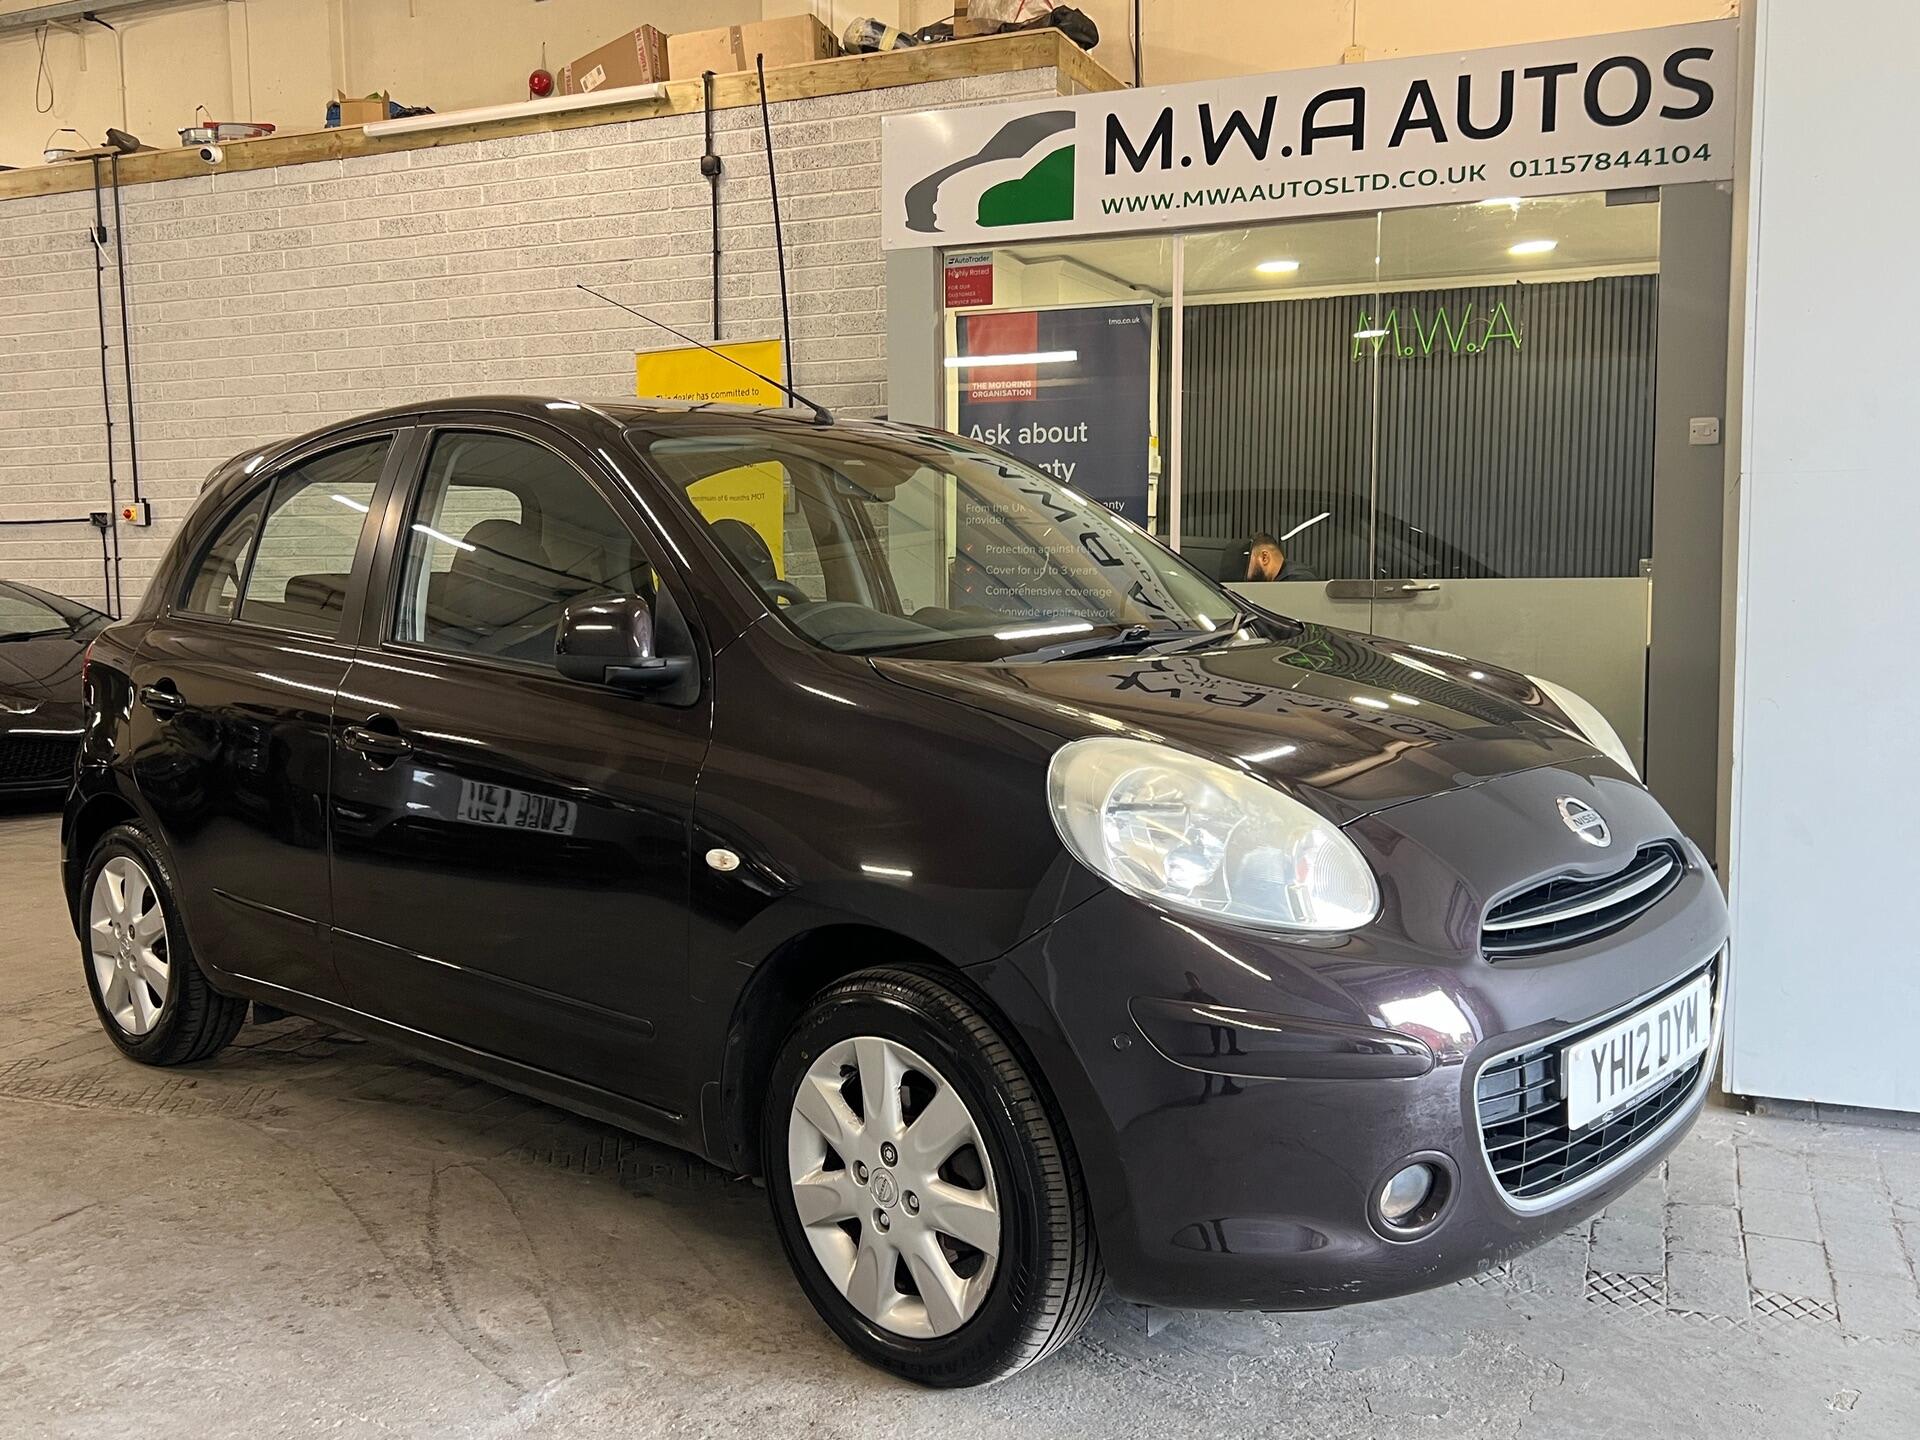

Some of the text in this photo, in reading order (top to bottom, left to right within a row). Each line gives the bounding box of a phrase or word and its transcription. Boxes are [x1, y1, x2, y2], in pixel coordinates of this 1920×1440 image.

[1104, 47, 1715, 176] M.W.A AUTOS
[1101, 143, 1711, 215] WWW.MWAAUTOSLTD.CO.UK 01157844104
[1108, 316, 1141, 325] tmo.co.uk
[1352, 301, 1521, 360] M.W.A
[972, 380, 1032, 390] THE MOTORING
[696, 390, 709, 400] has
[710, 388, 750, 399] committed
[751, 387, 760, 396] to
[972, 388, 1032, 398] ORGANISATION
[969, 421, 1088, 445] Ask about
[750, 492, 765, 501] MOT
[965, 503, 992, 514] From
[993, 503, 1009, 513] the
[965, 516, 1006, 526] provider
[985, 544, 1037, 555] Protection
[1039, 545, 1075, 556] against
[985, 565, 1098, 578] Cover for up to 3 years
[985, 585, 1113, 599] Comprehensive coverage
[1042, 607, 1072, 619] repair
[1073, 607, 1116, 618] network
[1591, 1021, 1650, 1105] YH12
[1658, 991, 1698, 1069] DYM
